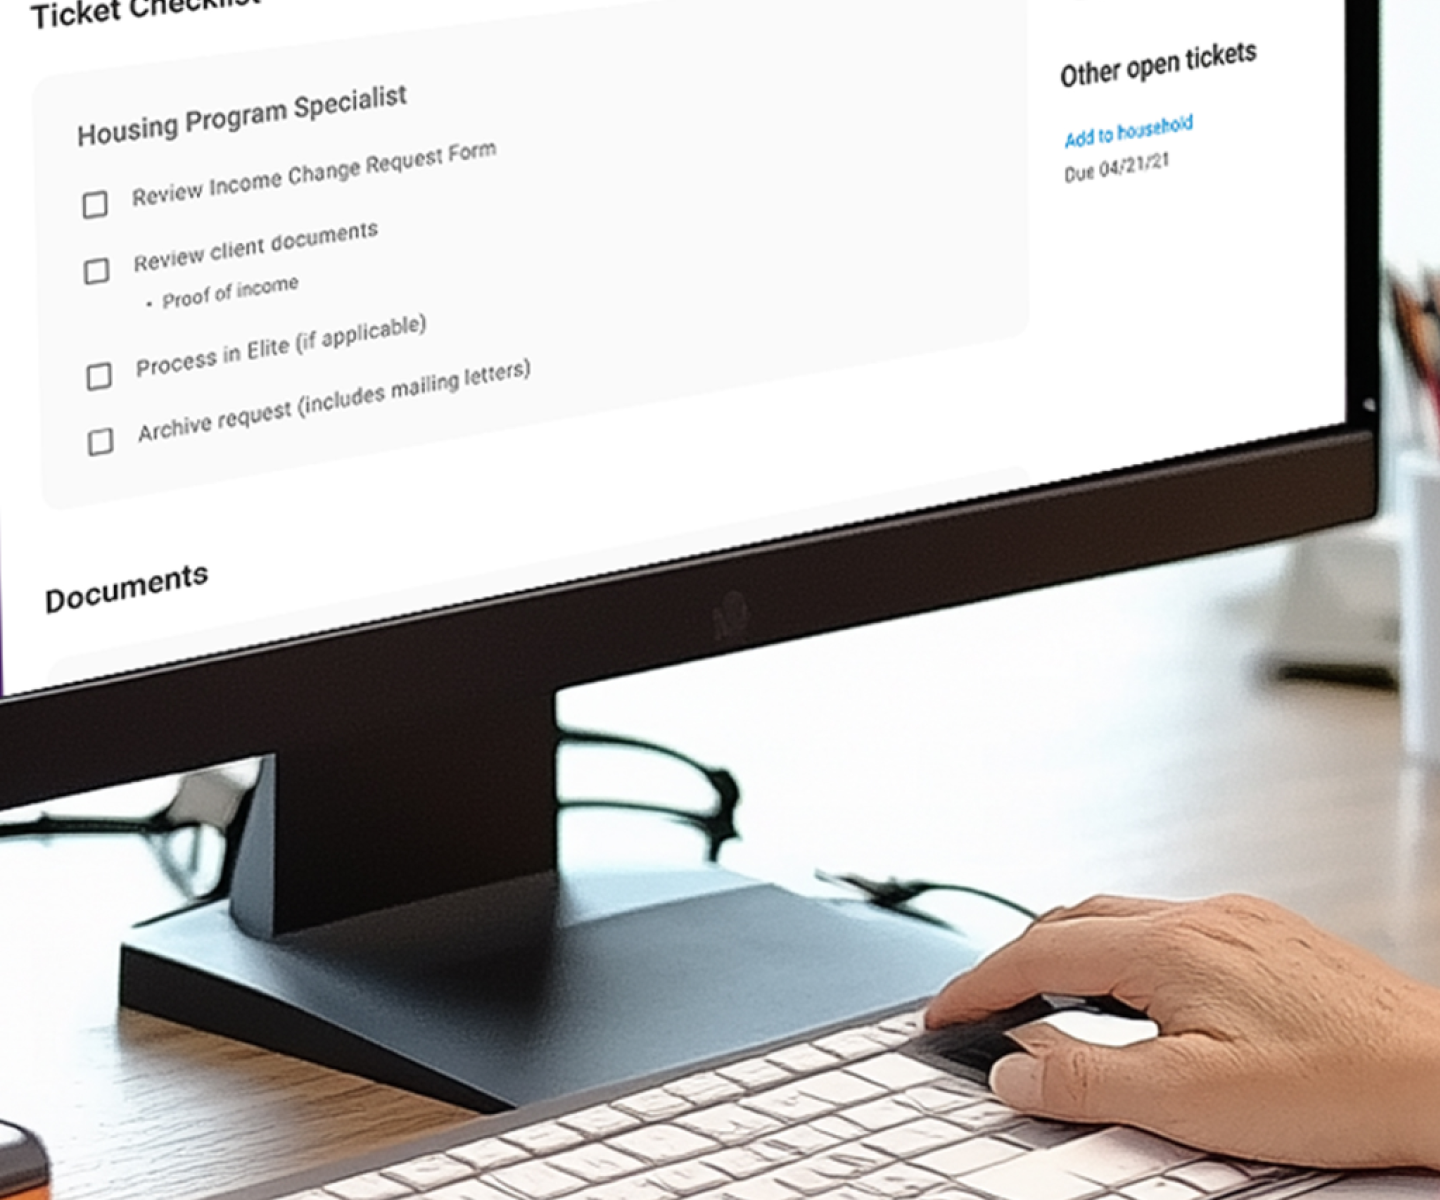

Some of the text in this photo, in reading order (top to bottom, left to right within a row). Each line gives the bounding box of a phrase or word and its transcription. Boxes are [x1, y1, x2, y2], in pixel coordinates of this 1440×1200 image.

[1060, 42, 1258, 88] Other open tickets
[77, 84, 408, 148] Housing Program Specialist
[1064, 128, 1095, 150] Add
[1098, 128, 1114, 144] to
[132, 142, 497, 207] Review Income Change Request Form
[1064, 150, 1169, 185] Due 04/21/21
[134, 222, 379, 273] Review client documents
[162, 276, 300, 310] Proof of income
[136, 312, 427, 378] Process in Elite (if applicable)
[137, 357, 531, 443] Archive request (includes mailing letters)
[45, 564, 209, 615] Documents
